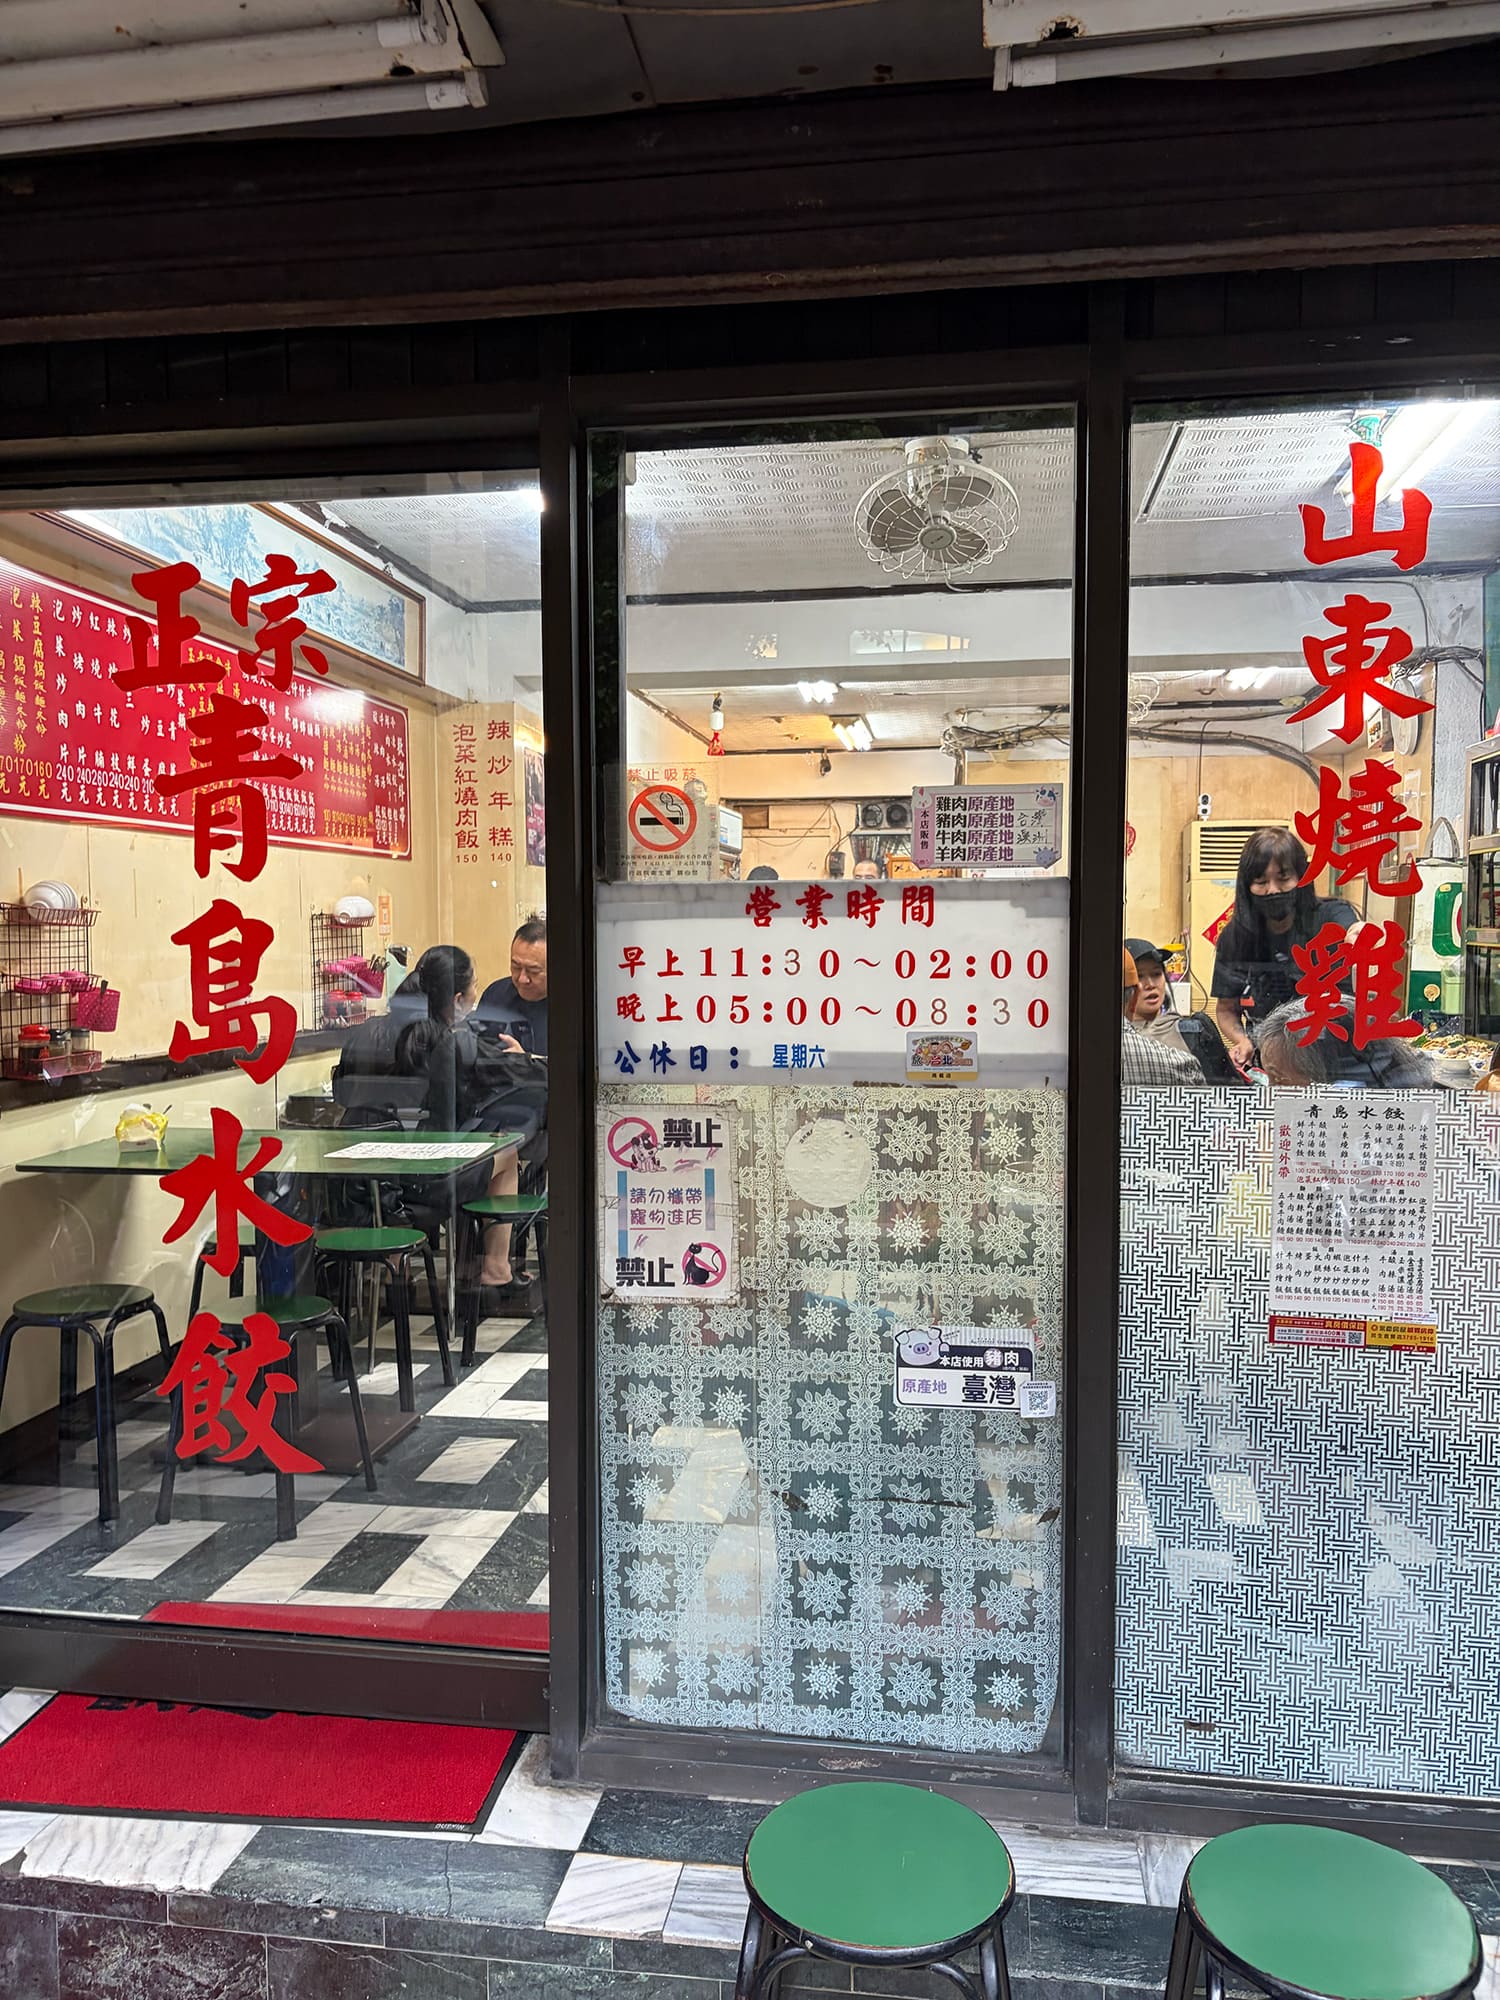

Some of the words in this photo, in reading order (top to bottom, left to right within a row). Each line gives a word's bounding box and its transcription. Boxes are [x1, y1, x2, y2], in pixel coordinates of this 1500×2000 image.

[111, 554, 337, 692] 正宗
[1286, 442, 1435, 1050] 山東燒雞
[453, 724, 479, 849] 泡菜紅燒肉飯
[488, 720, 514, 847] 辣炒年糕
[936, 796, 1014, 812] 雞肉原產地
[920, 810, 928, 850] 本店販售
[936, 812, 1014, 828] 豬肉原產地
[936, 830, 1014, 845] 牛肉原產地
[456, 854, 478, 863] 150
[491, 853, 512, 862] 140
[936, 846, 1014, 862] 羊肉原產地
[745, 884, 936, 929] 營業時間
[772, 1044, 826, 1069] 星期六
[153, 692, 325, 1473] 青島水餃
[1304, 1104, 1405, 1120] 青島水餃
[662, 1118, 723, 1148] 禁止
[1278, 1124, 1291, 1179] 歡迎外帶
[630, 1187, 702, 1205] 請勿攜帶
[630, 1208, 702, 1226] 寵物進店
[616, 1256, 676, 1288] 禁止
[939, 1348, 1020, 1368] 本店使用豬肉
[902, 1378, 948, 1394] 原產地
[962, 1374, 1017, 1405] 臺灣
